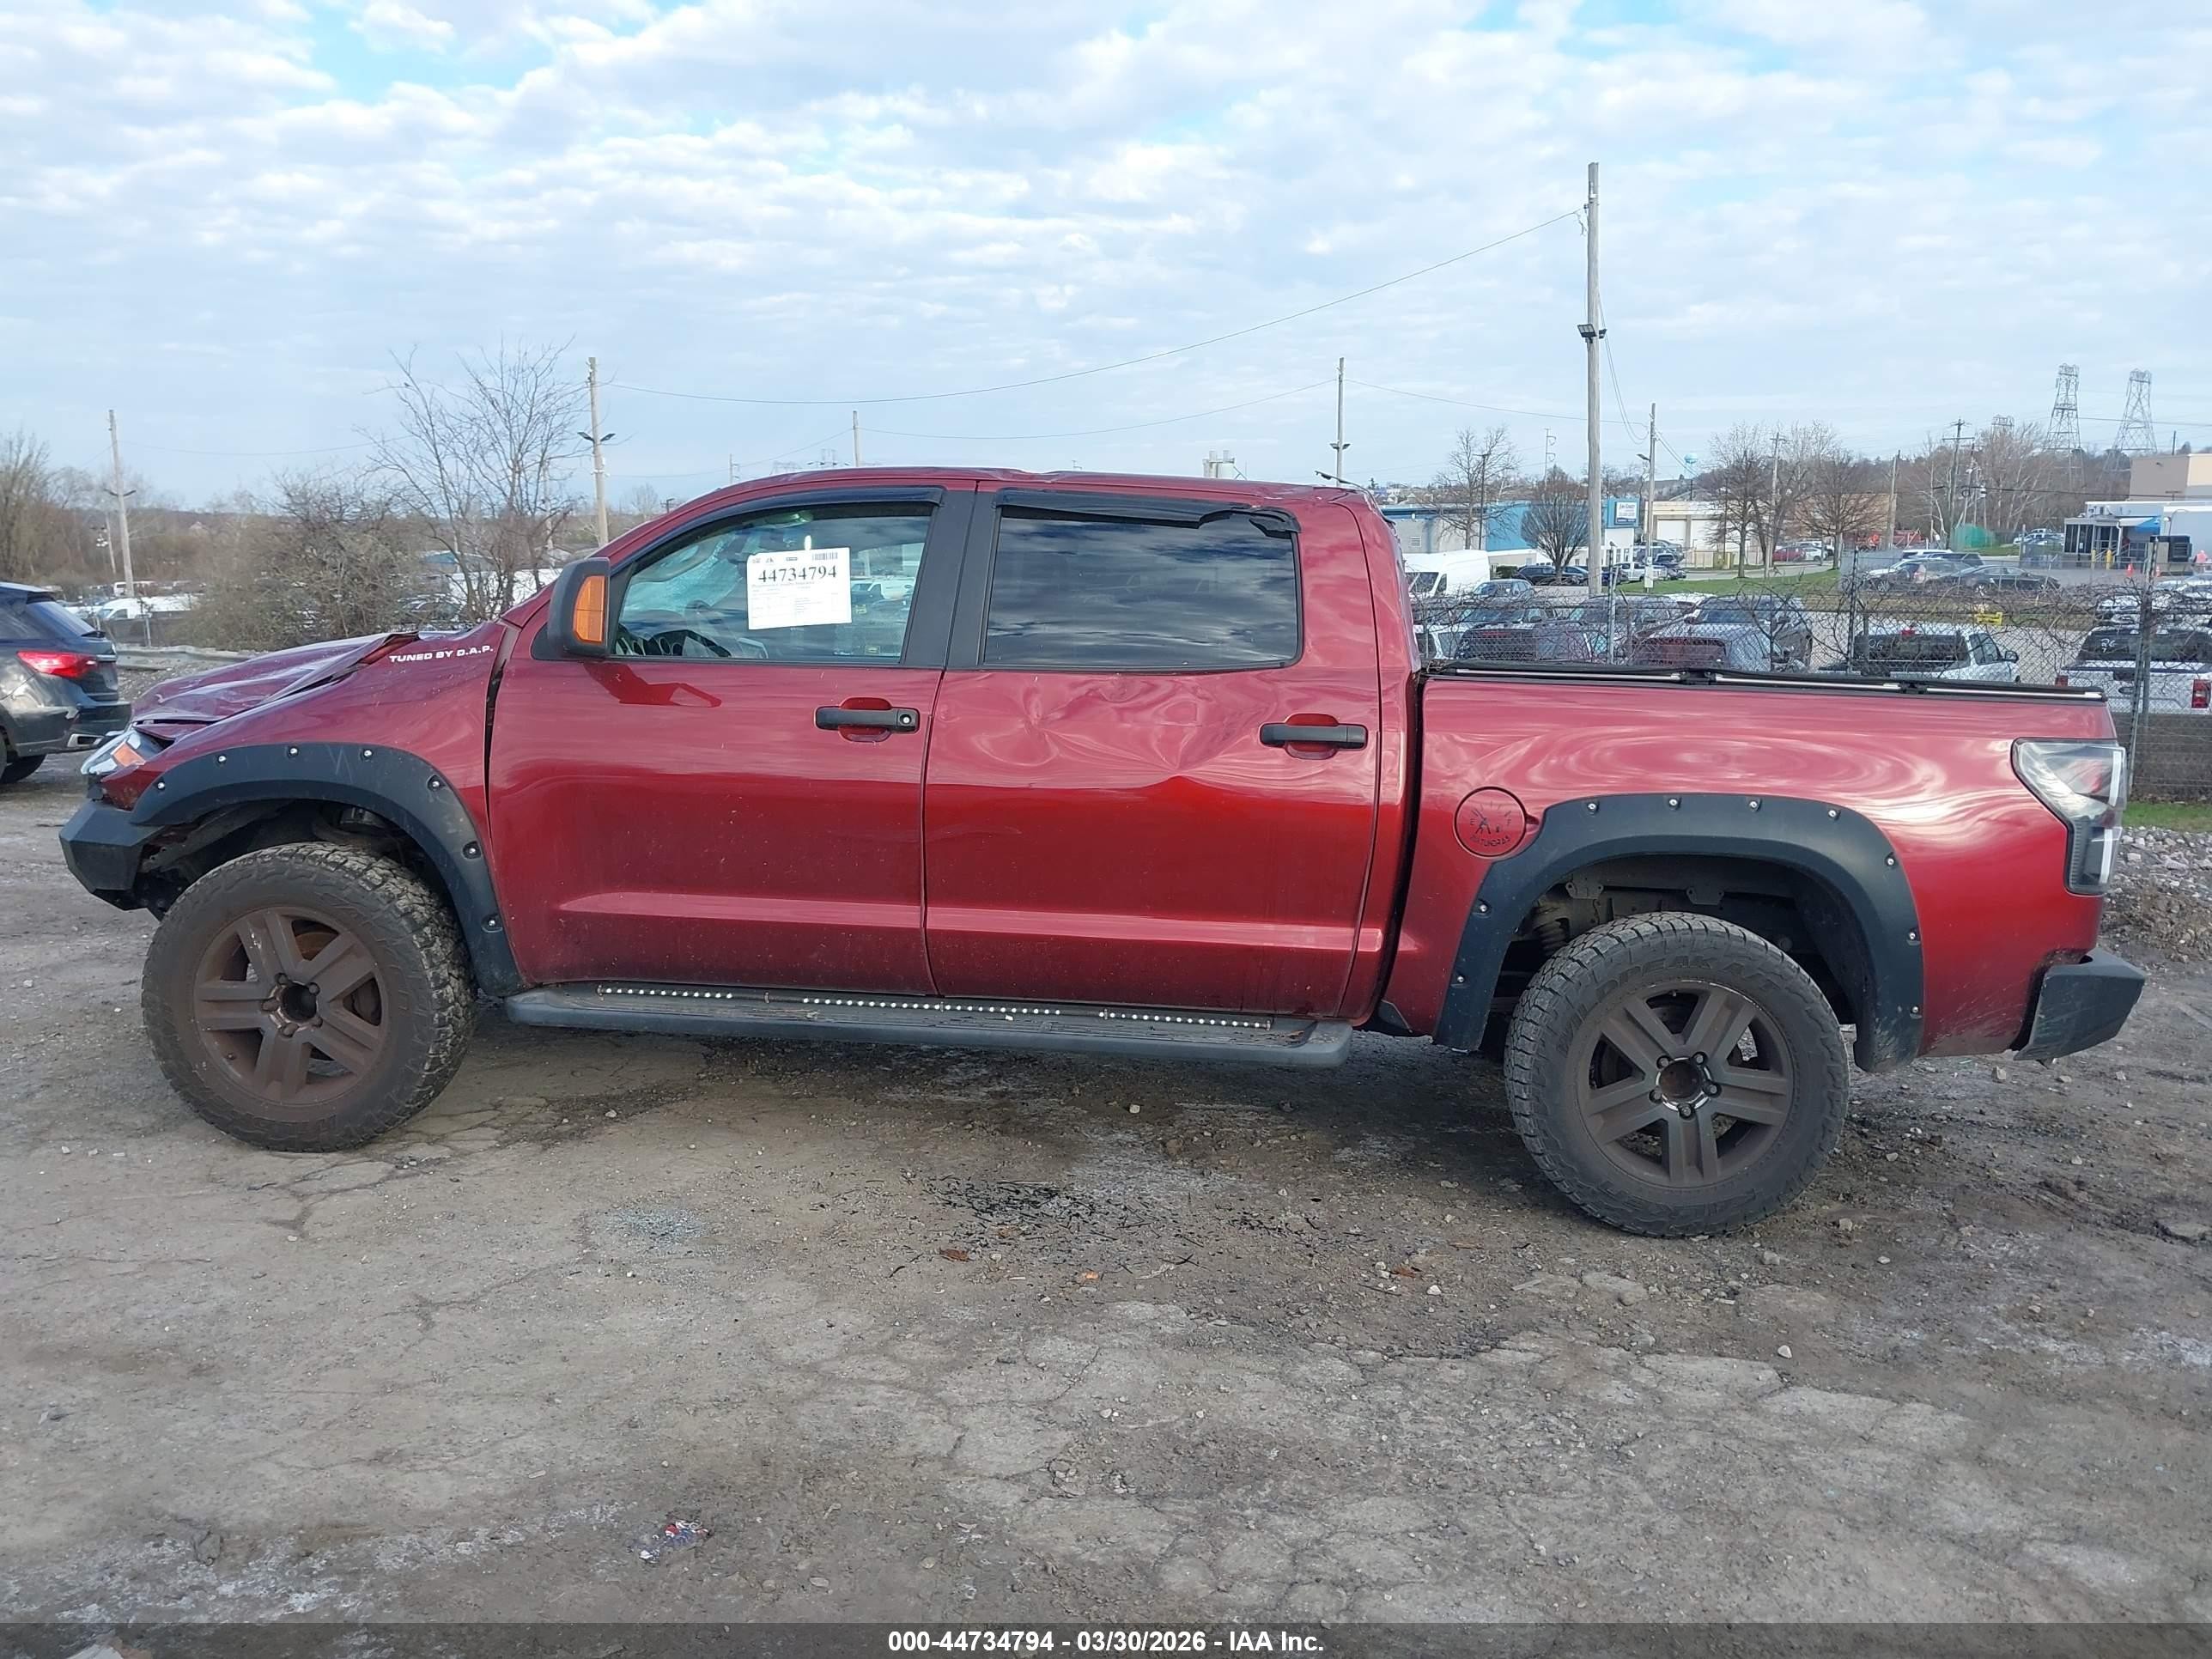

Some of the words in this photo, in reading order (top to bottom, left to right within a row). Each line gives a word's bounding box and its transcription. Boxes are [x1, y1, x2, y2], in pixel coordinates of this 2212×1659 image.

[758, 564, 837, 582] 44734794
[389, 653, 433, 662] TUNED
[435, 650, 454, 659] BY
